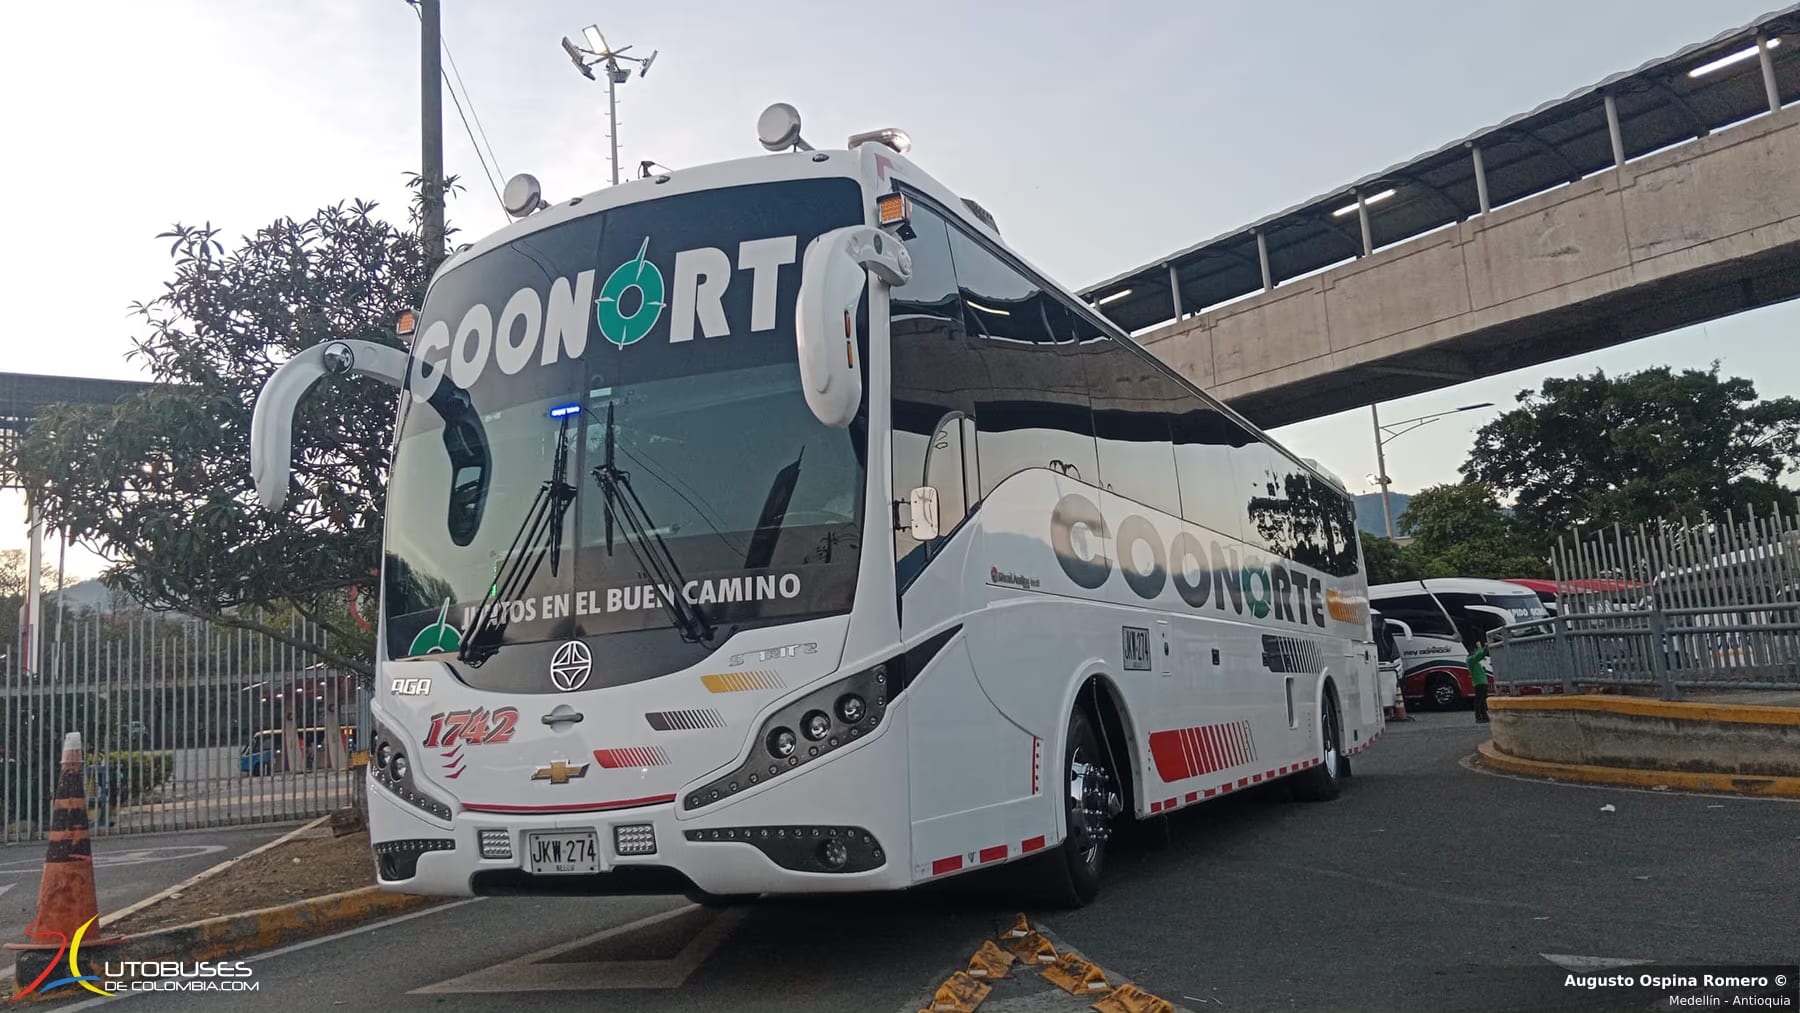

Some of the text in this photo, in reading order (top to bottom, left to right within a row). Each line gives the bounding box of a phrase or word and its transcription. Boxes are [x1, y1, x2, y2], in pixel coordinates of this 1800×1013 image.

[410, 235, 798, 404] COONORT
[1051, 494, 1326, 628] COONORTE
[542, 592, 570, 620] EN
[576, 590, 601, 615] EL
[607, 584, 675, 613] BUEN
[682, 573, 801, 605] CAMINO
[391, 678, 432, 696] AGA
[422, 705, 520, 749] 1742
[532, 839, 597, 863] JKW 274
